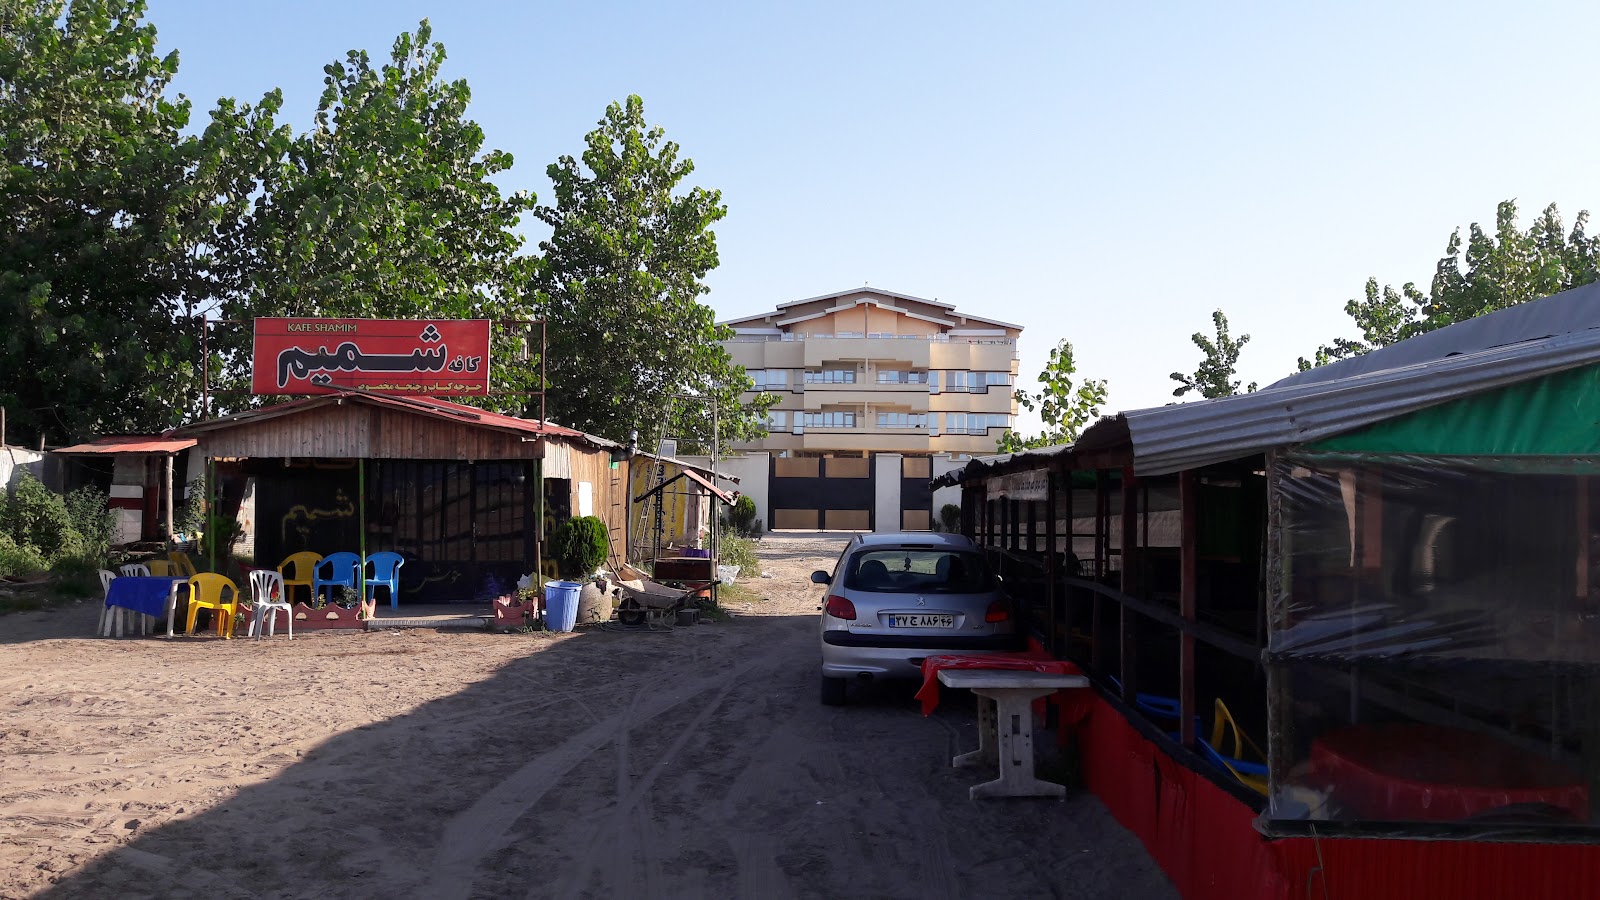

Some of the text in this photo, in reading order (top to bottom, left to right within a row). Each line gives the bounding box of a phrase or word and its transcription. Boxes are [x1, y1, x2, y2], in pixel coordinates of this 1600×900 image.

[287, 323, 357, 332] KAFE SHAMIM
[277, 323, 482, 389] کافه شمیم
[428, 382, 453, 392] کباب
[453, 384, 482, 393] جوجه
